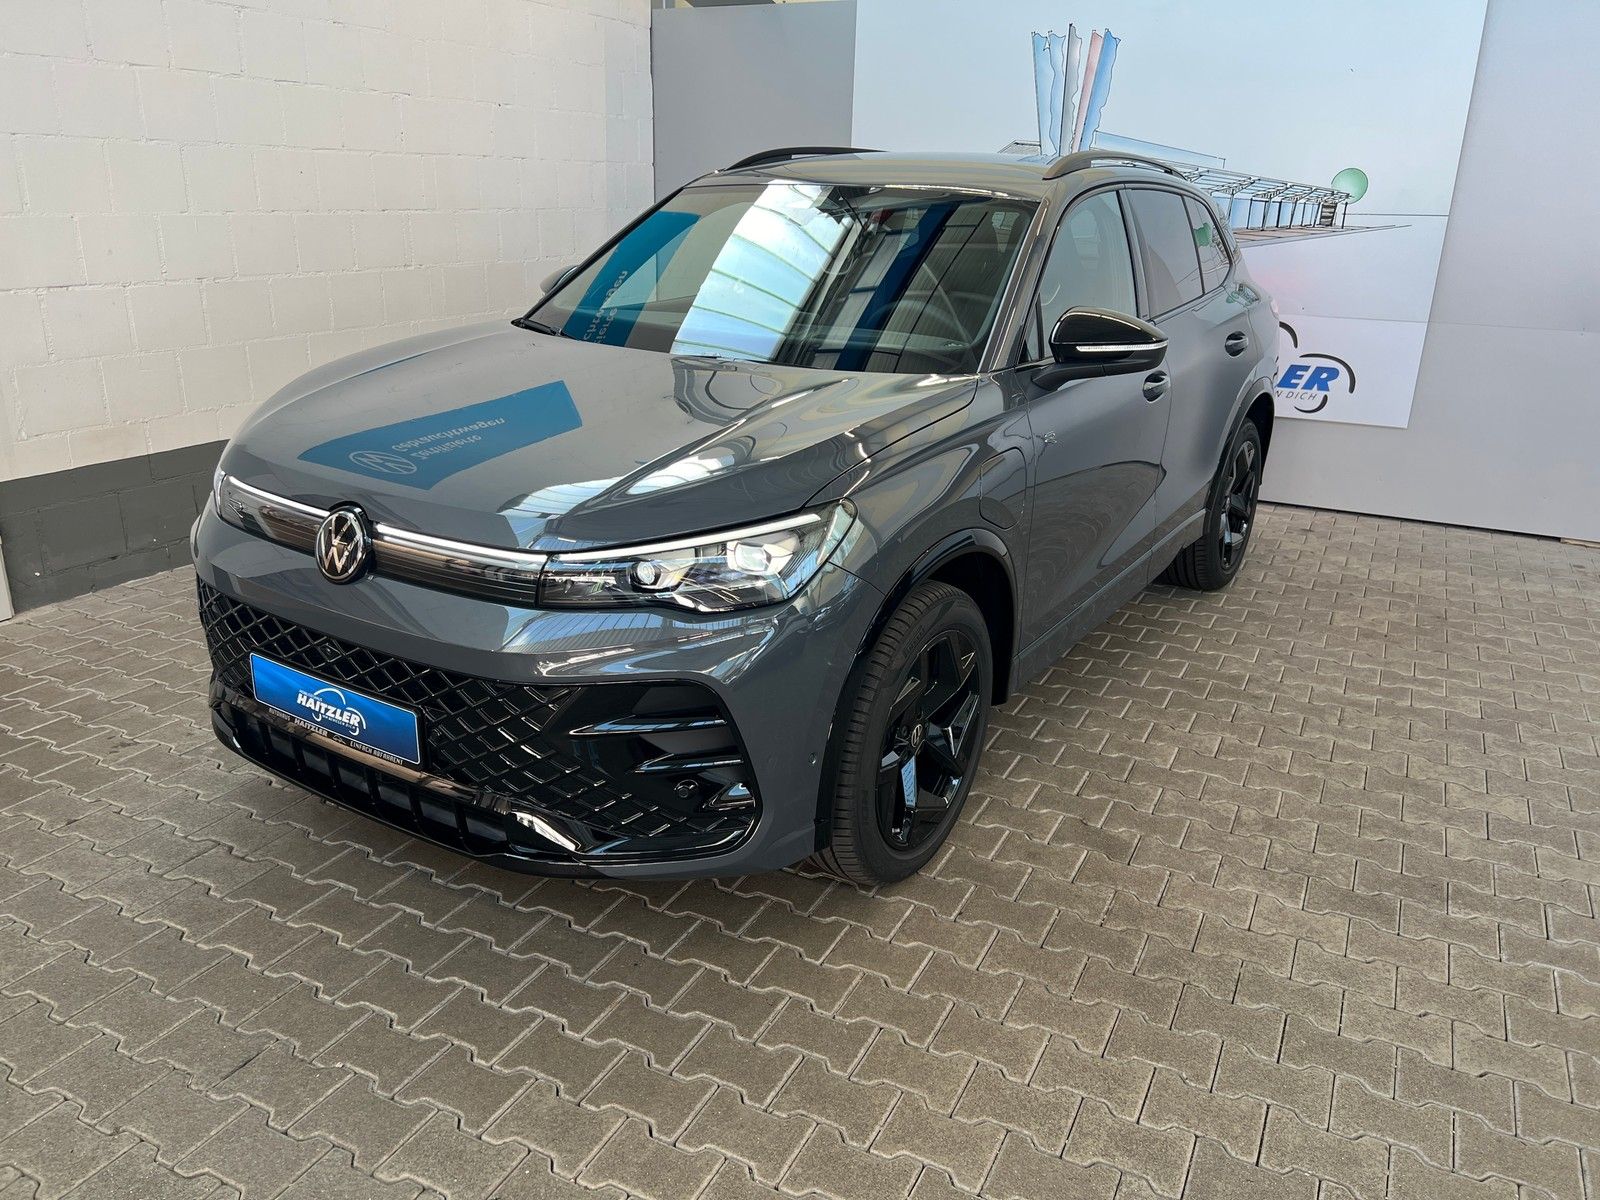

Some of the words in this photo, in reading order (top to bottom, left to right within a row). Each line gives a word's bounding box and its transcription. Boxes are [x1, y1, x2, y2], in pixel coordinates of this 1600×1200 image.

[1285, 391, 1318, 401] DICH
[296, 692, 361, 727] HAITZLER
[294, 716, 328, 737] HAITZLER
